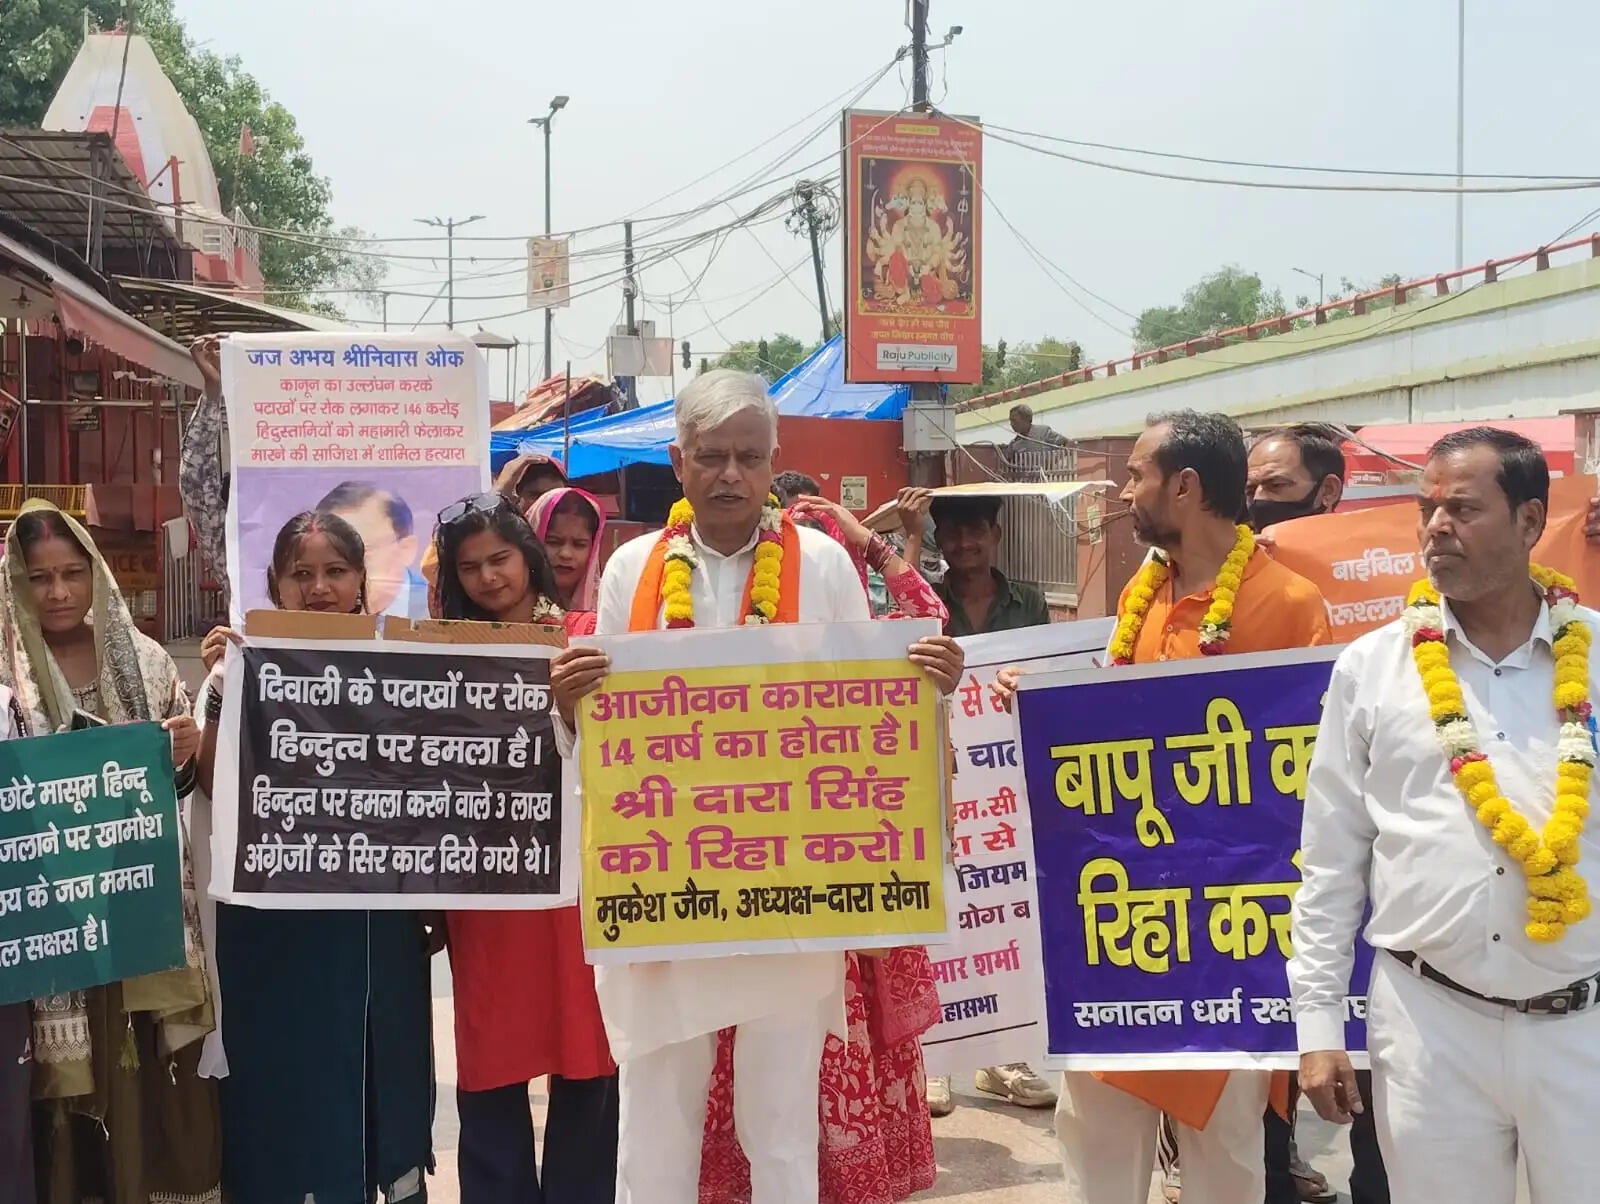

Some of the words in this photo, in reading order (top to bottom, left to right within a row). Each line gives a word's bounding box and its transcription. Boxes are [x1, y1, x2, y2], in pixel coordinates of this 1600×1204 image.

[246, 349, 282, 367] जज
[290, 350, 335, 367] अभय
[343, 344, 418, 367] श्रीनिवास
[426, 345, 464, 367] ओक
[883, 350, 906, 363] Raju
[908, 351, 953, 363] Publicity
[280, 378, 320, 398] कानून
[324, 379, 342, 393] का
[399, 375, 433, 393] करके
[299, 402, 316, 415] पर
[320, 399, 345, 415] रोक
[350, 402, 400, 416] लगाकर
[404, 403, 421, 415] 146
[336, 421, 354, 437] को
[358, 420, 409, 439] महामारी
[290, 444, 307, 461] की
[361, 444, 375, 460] में
[1331, 548, 1415, 581] बाईबिल
[258, 663, 343, 706] दिवाली
[348, 667, 376, 705] के
[382, 669, 464, 710] पटाखों
[465, 682, 499, 711] पर
[502, 672, 550, 712] रोक
[590, 675, 752, 722] आजीवन
[760, 677, 921, 712] कारावास
[959, 674, 984, 718] से
[269, 718, 370, 777] हिन्दुत्व
[376, 734, 416, 763] पर
[420, 735, 501, 766] हमला
[599, 736, 635, 768] 14
[645, 719, 703, 764] वर्ष
[713, 729, 768, 759] का
[777, 715, 862, 759] होता
[39, 774, 97, 815] मासूम
[102, 760, 154, 803] हिन्दू
[610, 774, 678, 820] श्री
[690, 781, 793, 815] दारा
[806, 765, 910, 812] सिंह
[1049, 738, 1177, 849] बापू
[1165, 696, 1253, 807] जी
[252, 774, 318, 832] हिन्दुत्व
[321, 787, 349, 817] पर
[350, 789, 402, 820] हमला
[406, 780, 452, 819] करने
[454, 781, 492, 821] वाले
[495, 793, 507, 819] 3
[510, 792, 553, 821] लाख
[64, 825, 91, 851] पर
[94, 808, 163, 848] खामोश
[597, 829, 673, 874] को
[685, 824, 790, 872] रिहा
[981, 821, 1017, 852] से
[244, 832, 315, 879] अंग्रेजों
[318, 834, 344, 872] के
[348, 832, 390, 874] सिर
[391, 845, 437, 874] काट
[439, 834, 479, 874] दिये
[482, 834, 520, 875] गये
[26, 874, 49, 908] के
[53, 874, 95, 903] जज
[99, 864, 155, 895] ममता
[595, 882, 667, 943] मुकेश
[671, 877, 728, 922] जैन,
[880, 869, 931, 911] सेना
[1077, 857, 1192, 975] रिहा
[0, 939, 21, 968] ल
[972, 939, 1020, 977] शर्मा
[938, 994, 998, 1024] हासभा
[1073, 999, 1183, 1028] सनातन
[1191, 987, 1244, 1026] धर्म
